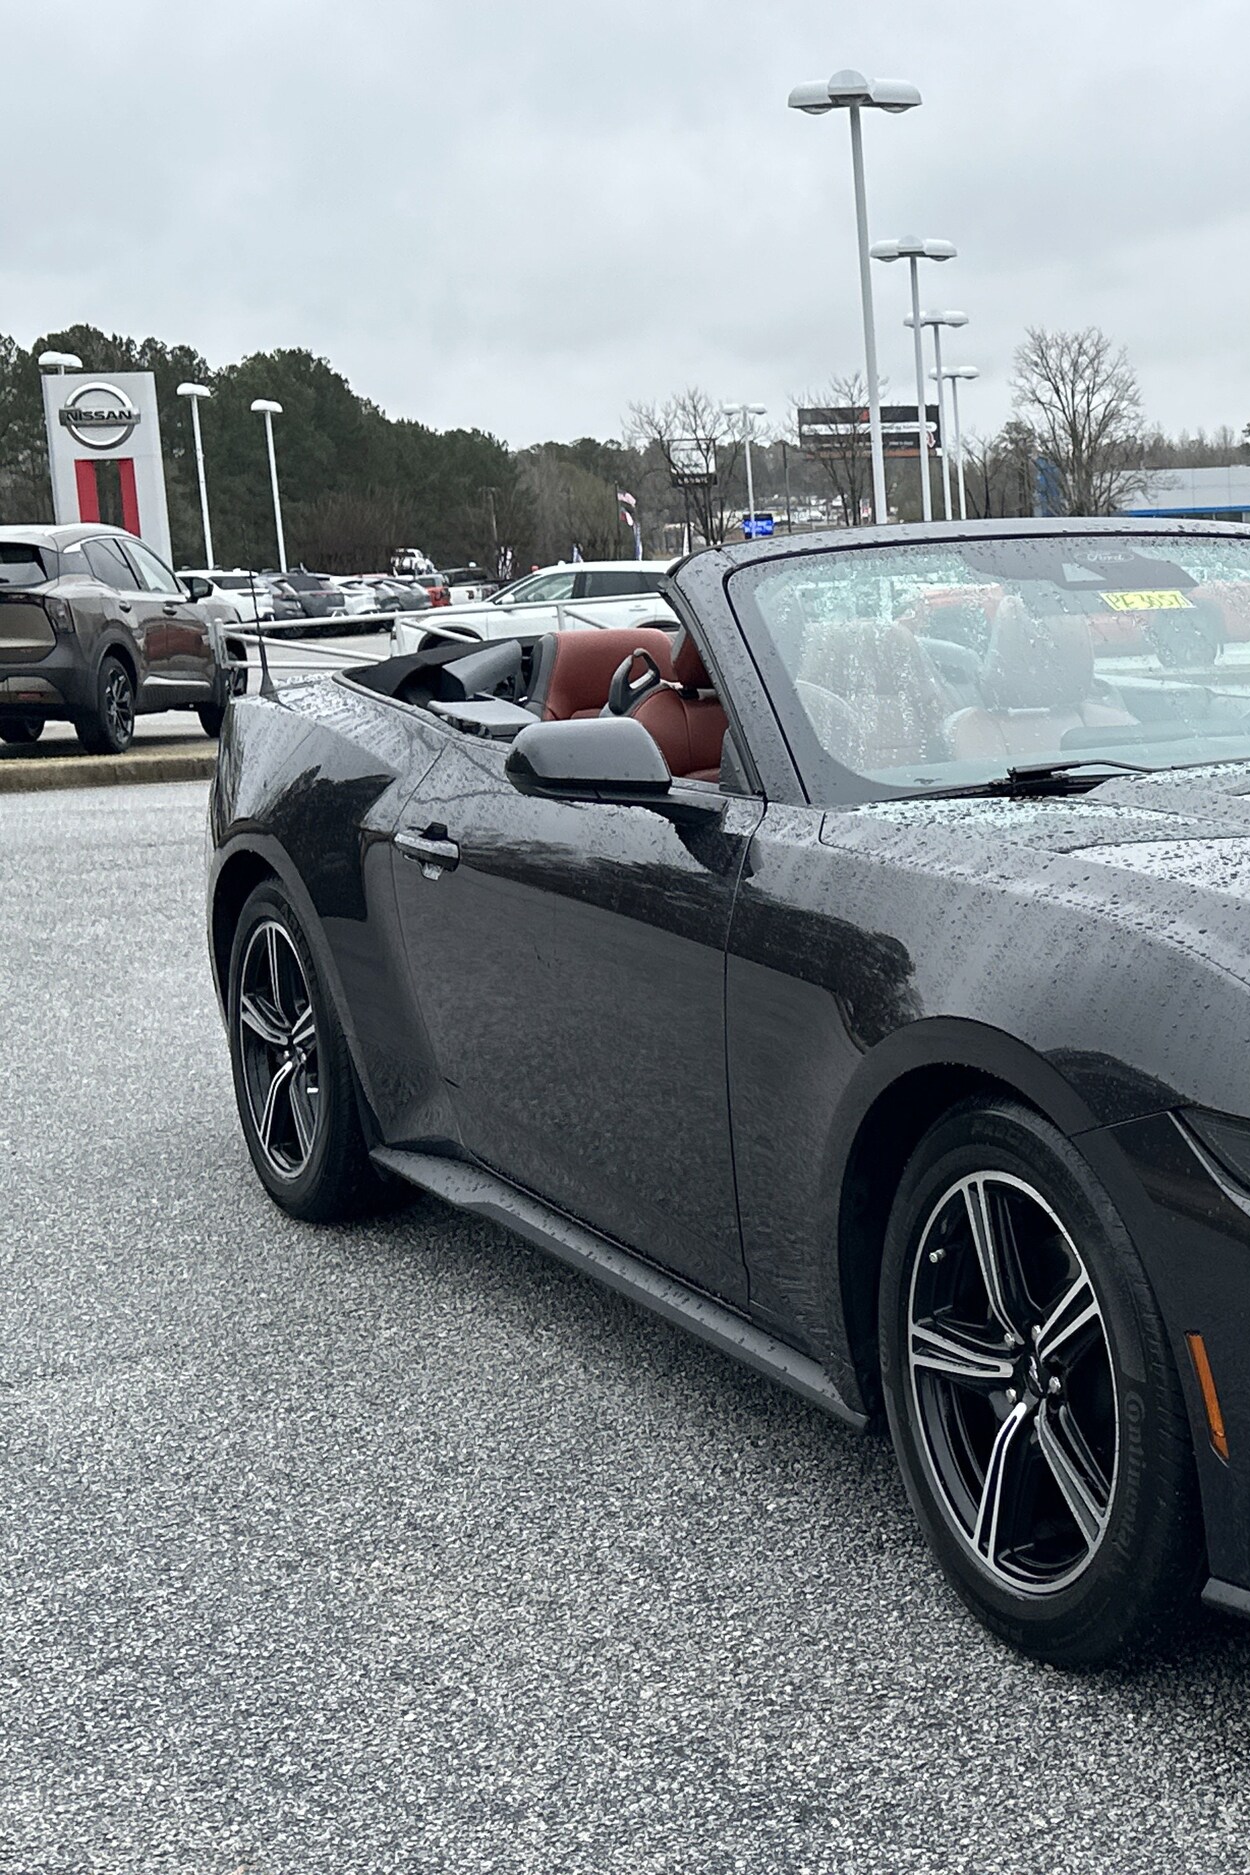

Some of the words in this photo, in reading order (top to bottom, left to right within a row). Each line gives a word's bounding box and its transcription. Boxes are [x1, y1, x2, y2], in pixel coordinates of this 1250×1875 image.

[66, 410, 132, 422] NISSAN
[1086, 551, 1126, 562] Ford
[1112, 1390, 1146, 1560] Continental
